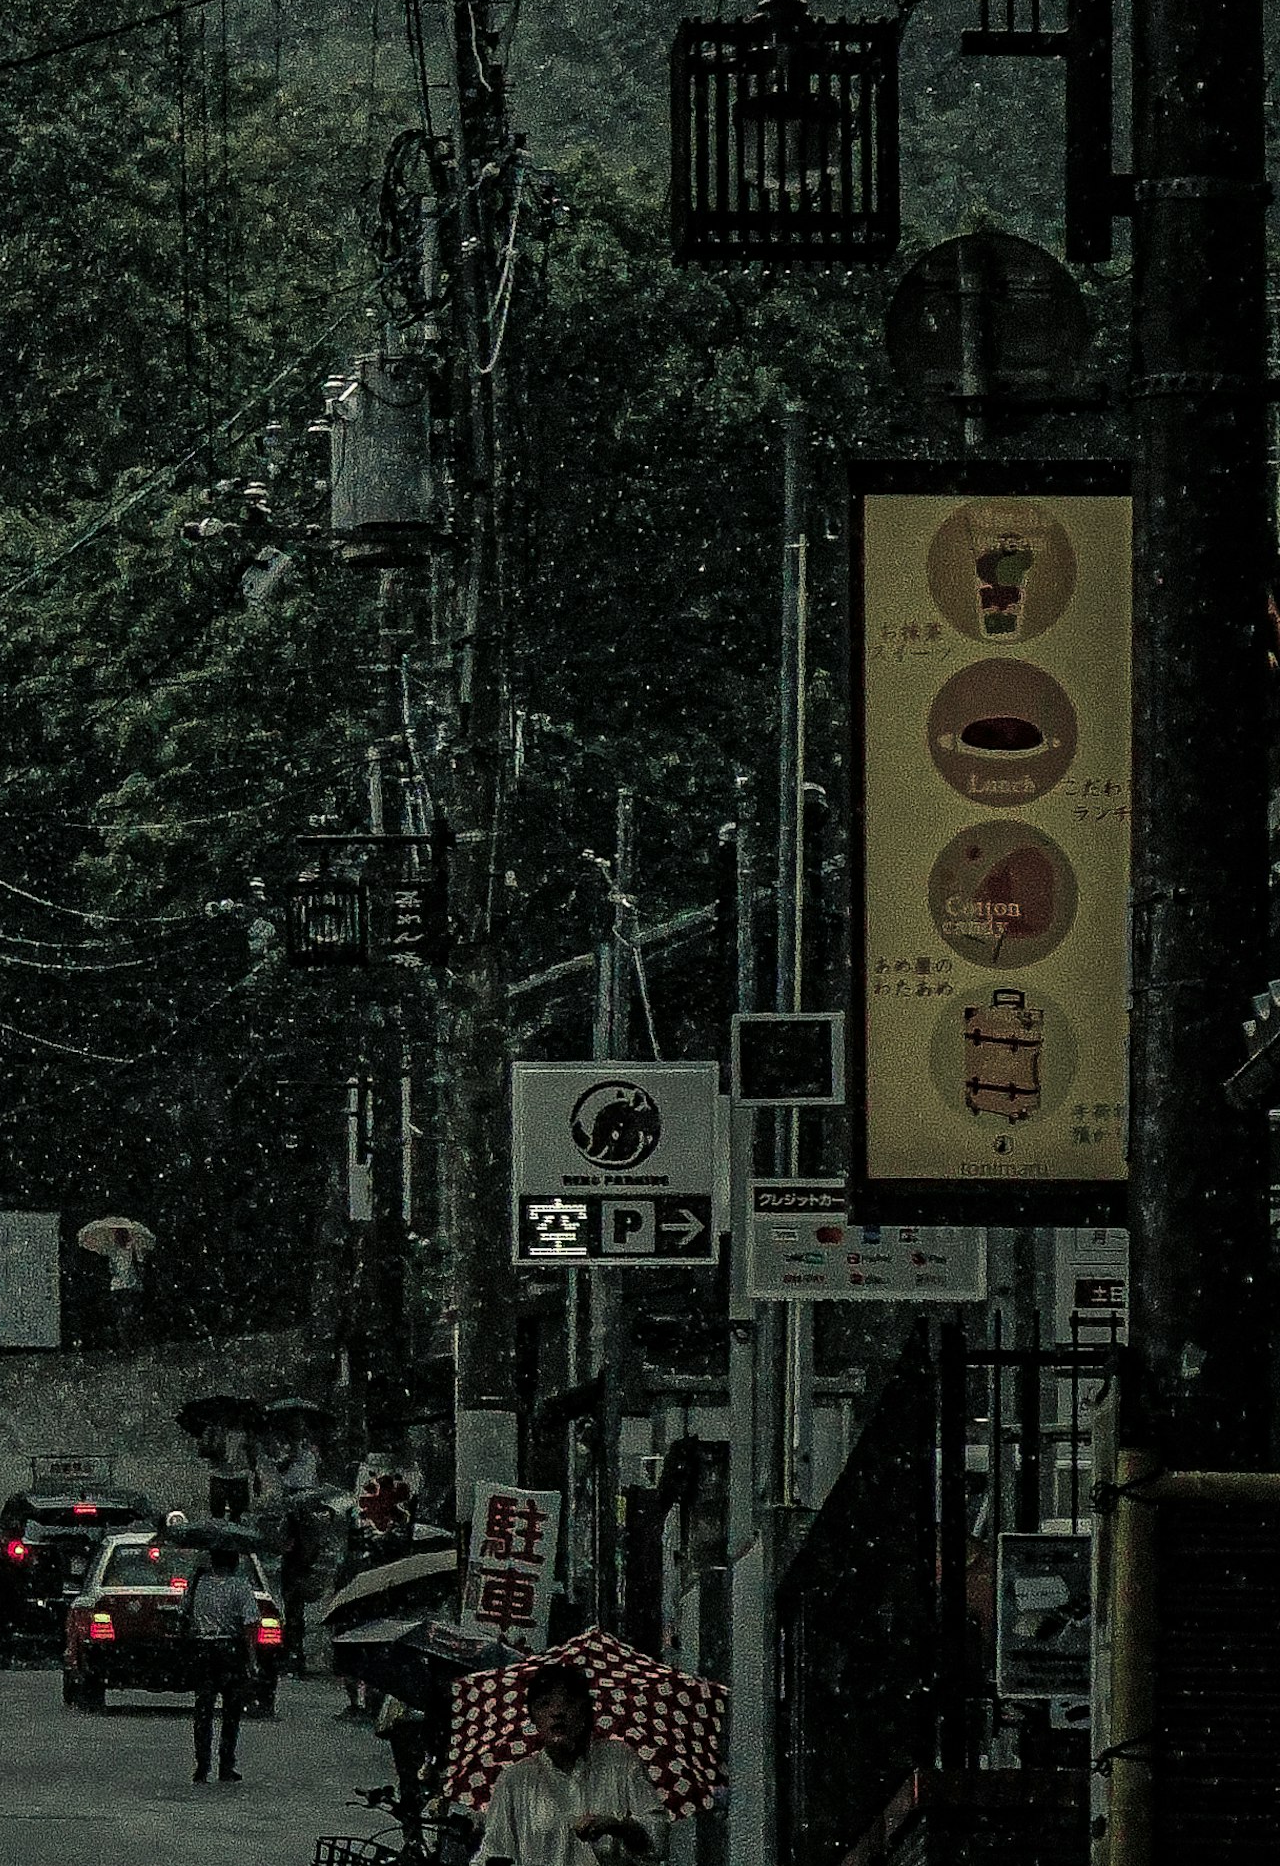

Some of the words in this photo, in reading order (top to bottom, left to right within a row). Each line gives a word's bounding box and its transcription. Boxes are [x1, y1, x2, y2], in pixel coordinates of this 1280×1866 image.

[1064, 779, 1132, 797] こだわ
[945, 895, 1022, 917] Cotton
[527, 1197, 589, 1256] 空
[613, 1209, 642, 1244] P
[476, 1494, 547, 1655] 駐車
